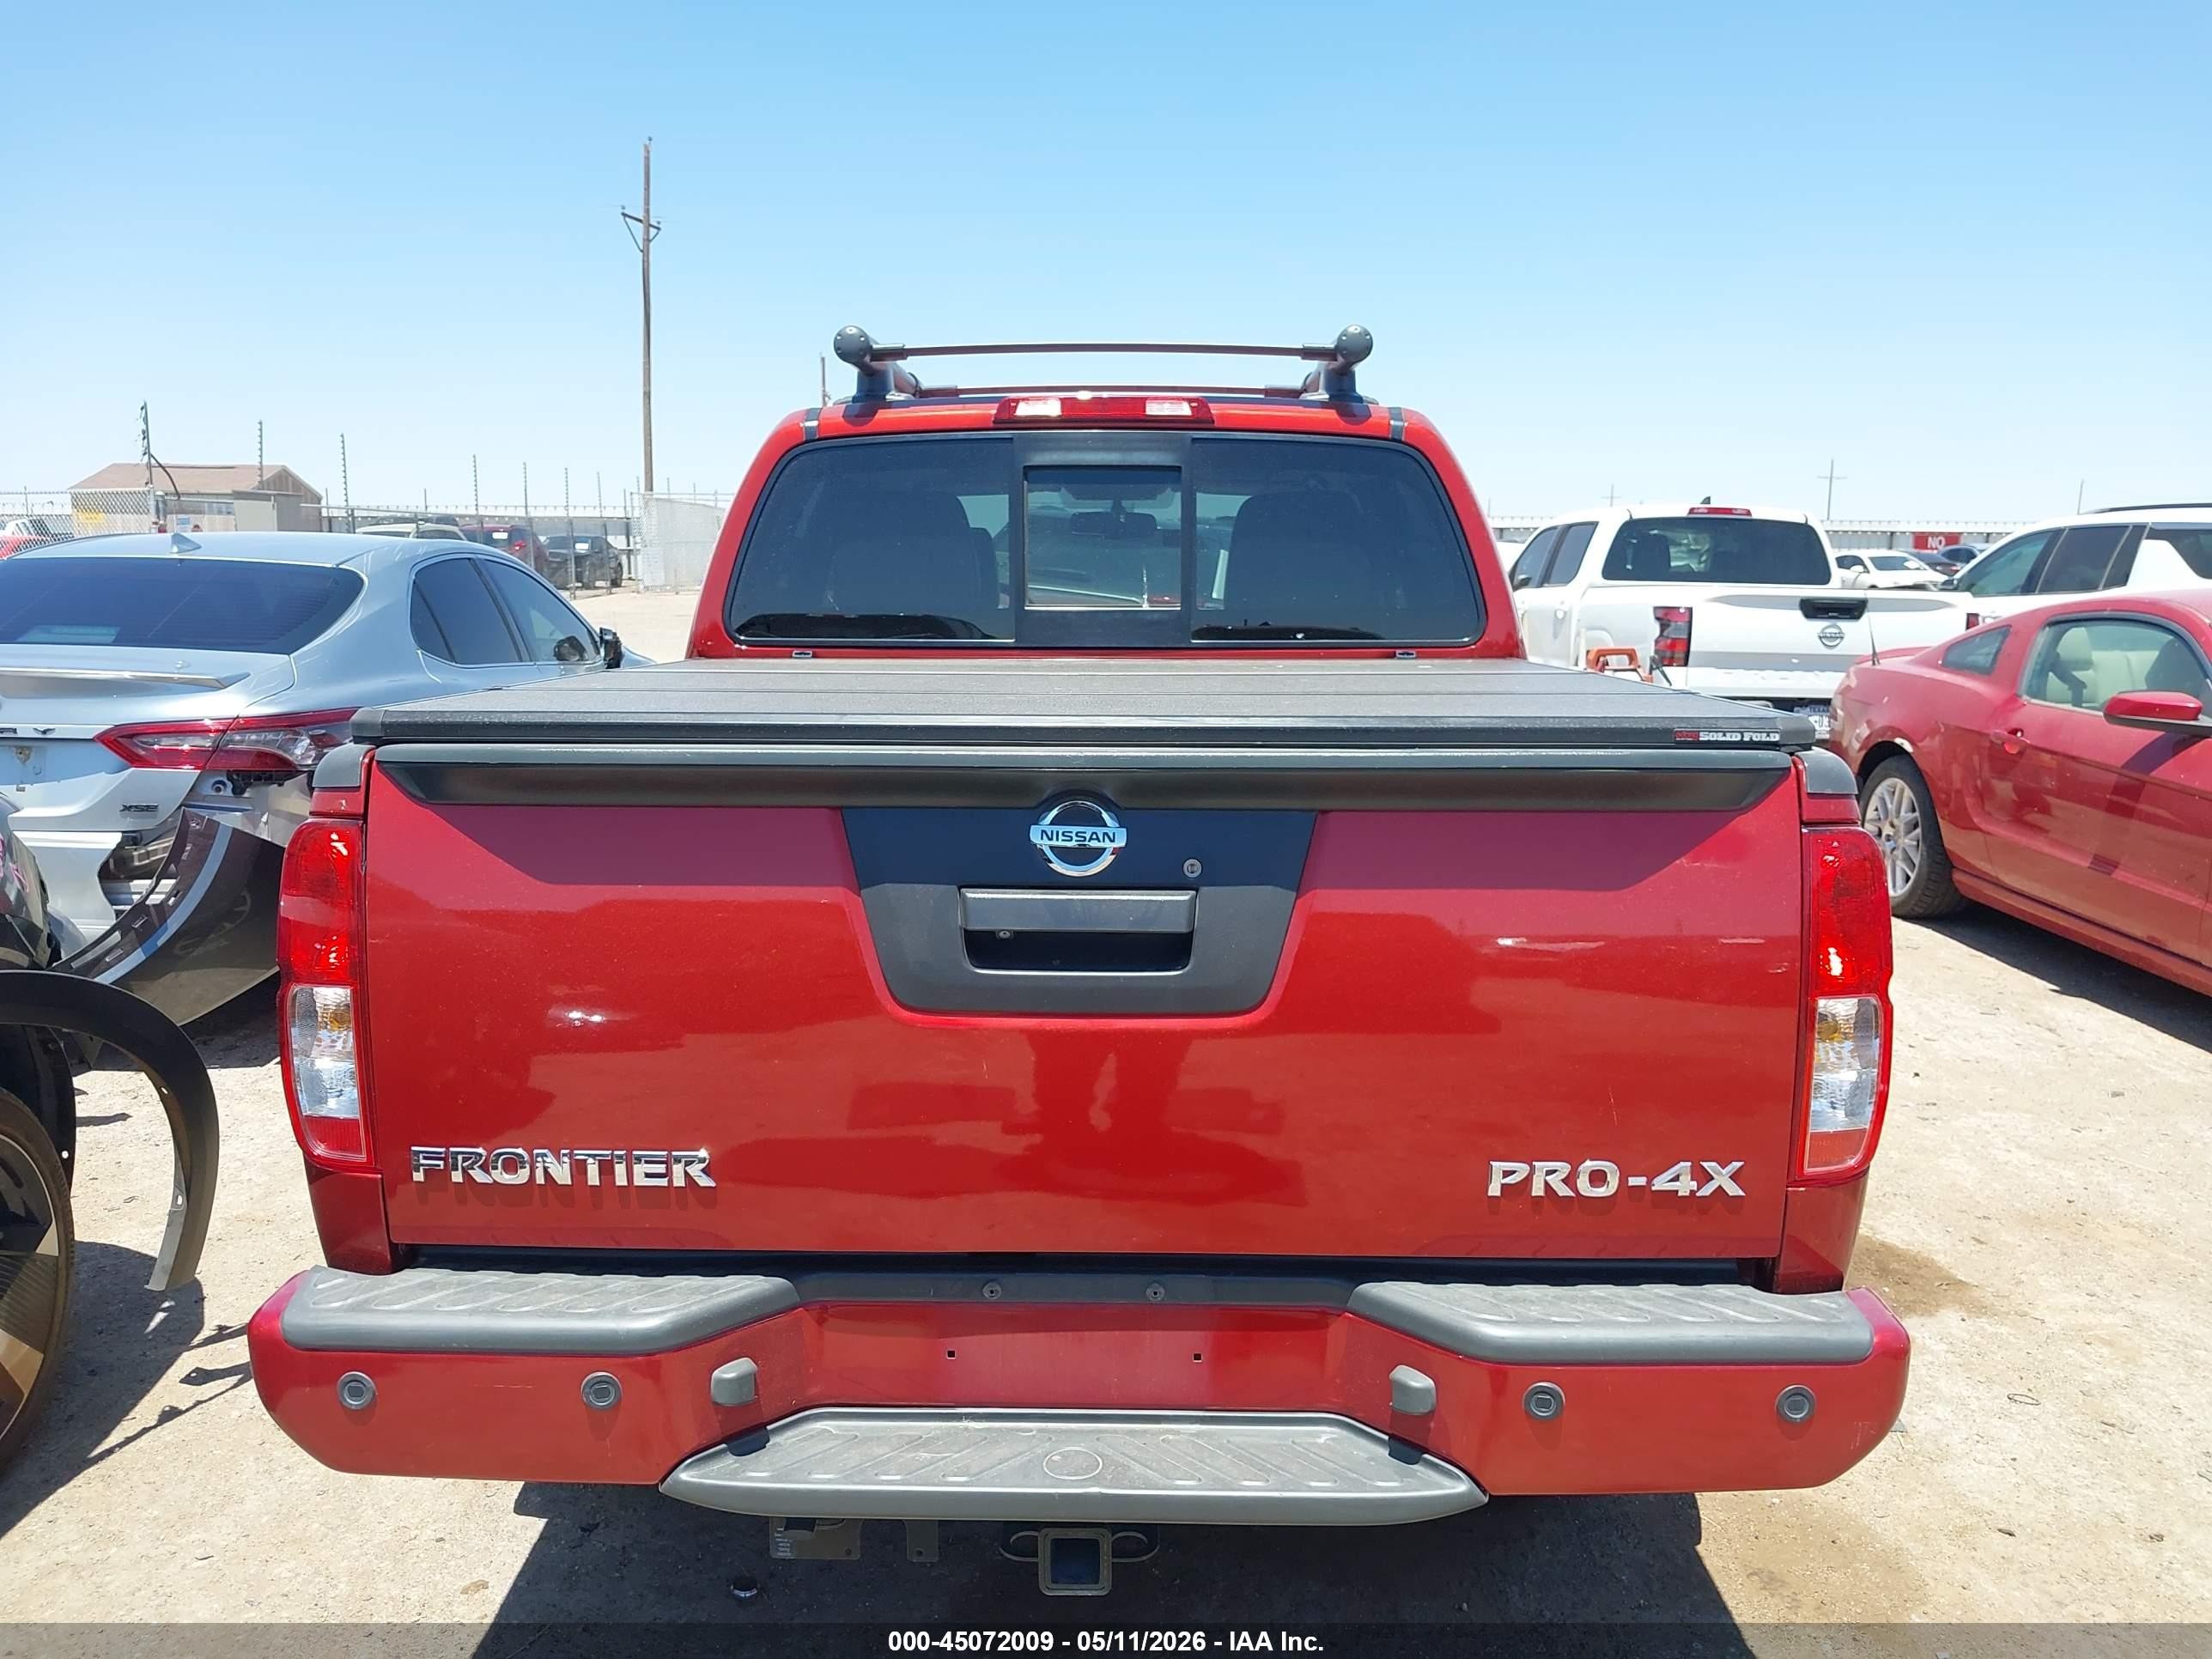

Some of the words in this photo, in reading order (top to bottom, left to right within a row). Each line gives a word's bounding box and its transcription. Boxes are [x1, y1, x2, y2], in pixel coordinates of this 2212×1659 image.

[1927, 536, 1946, 549] NO
[1698, 731, 1741, 742] SOLID
[1743, 731, 1780, 742] FOLD
[119, 804, 159, 812] XSE
[1040, 829, 1116, 843] NISSAN
[410, 1146, 716, 1188] FRONTIER
[1487, 1159, 1746, 1197] PRO-4X
